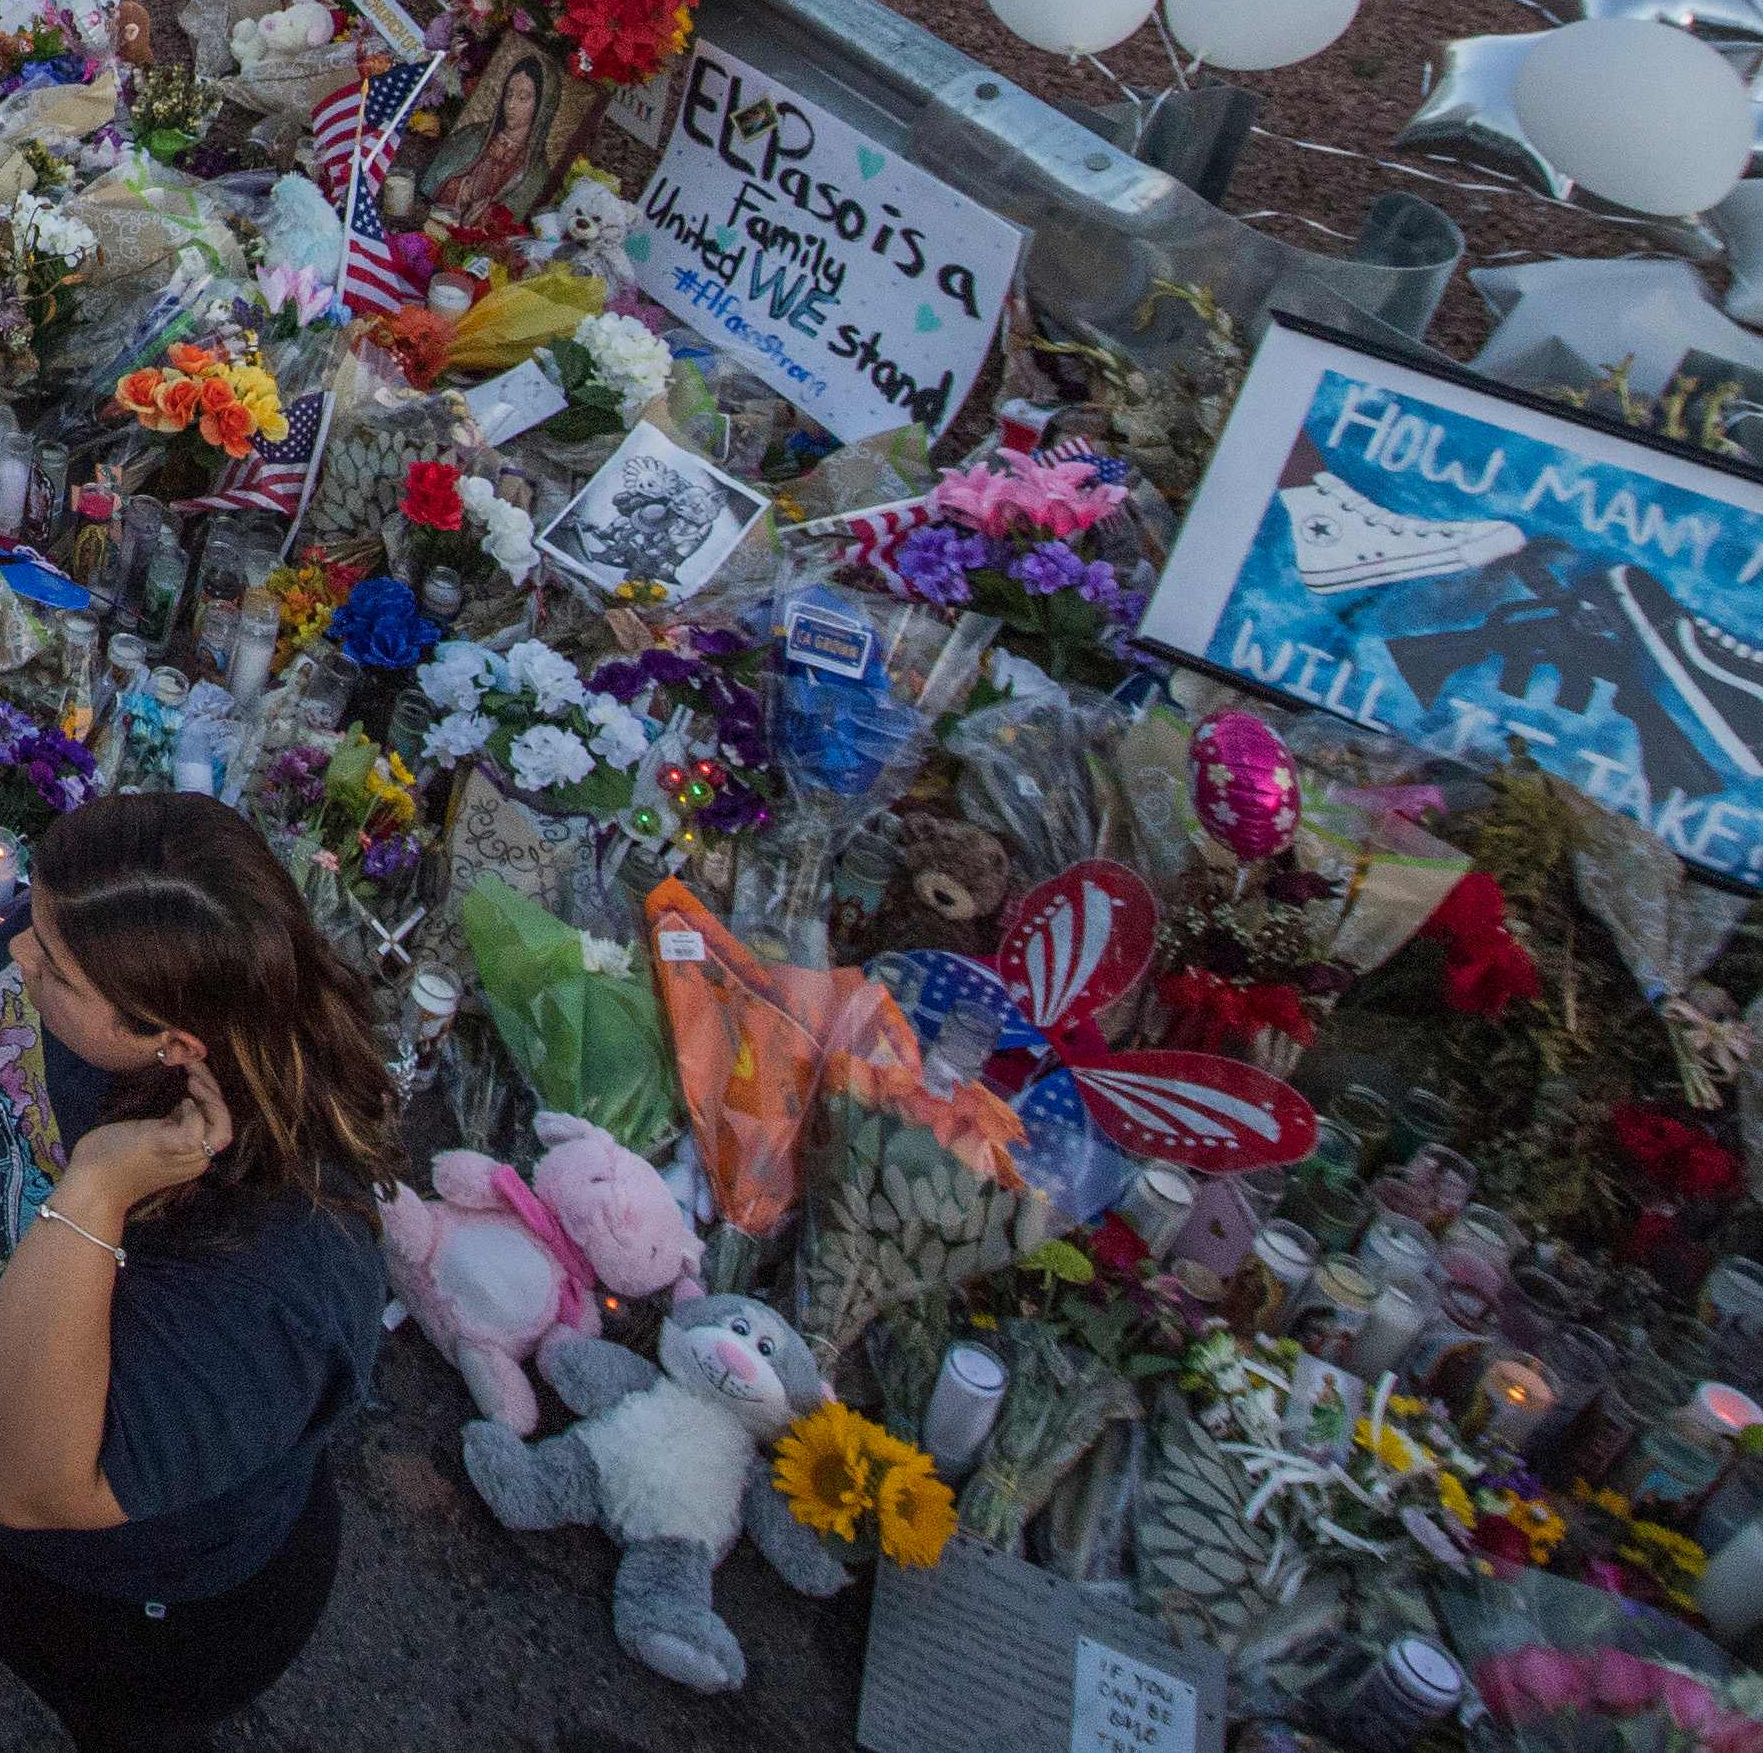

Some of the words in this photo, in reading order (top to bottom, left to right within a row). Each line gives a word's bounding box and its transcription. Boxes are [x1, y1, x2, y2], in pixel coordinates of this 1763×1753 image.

[399, 34, 420, 56] OF
[727, 181, 847, 302] Family
[759, 96, 869, 242] Paso
[870, 204, 927, 278] is
[937, 263, 985, 322] a
[643, 178, 748, 286] United
[746, 248, 843, 342] WE
[827, 322, 956, 432] stand
[1327, 383, 1507, 496] HOW
[1527, 472, 1722, 570] MANY
[1230, 619, 1392, 734] WILL
[1098, 1659, 1122, 1679] IF
[1135, 1673, 1175, 1704] YOU
[1098, 1679, 1138, 1709] CAN
[1147, 1702, 1172, 1725] BE
